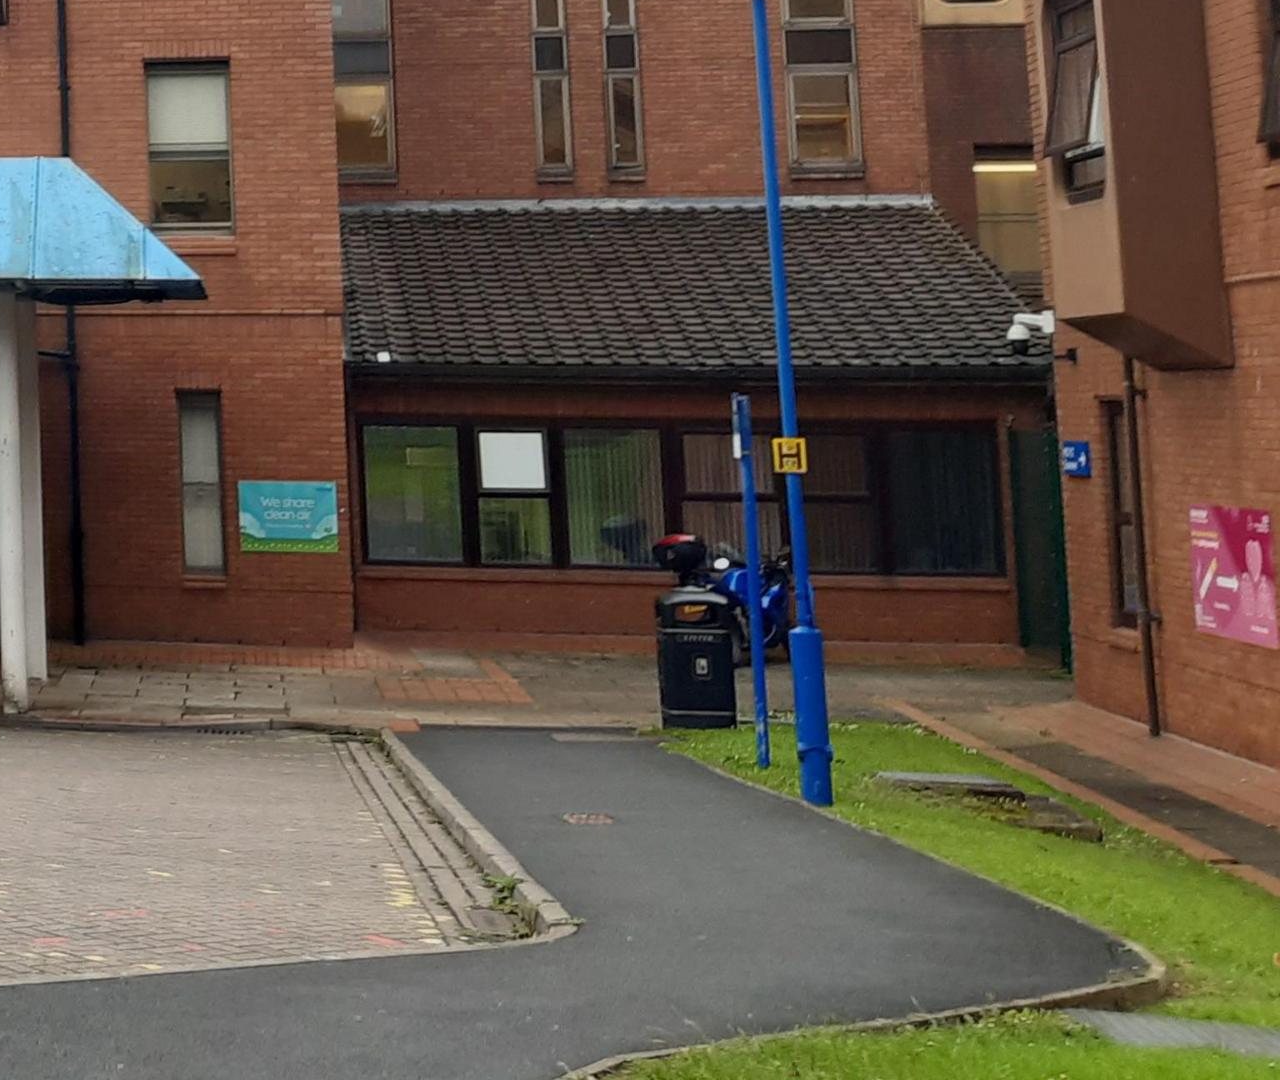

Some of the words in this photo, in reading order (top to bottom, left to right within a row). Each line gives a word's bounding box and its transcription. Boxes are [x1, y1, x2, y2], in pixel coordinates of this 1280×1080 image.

[260, 496, 280, 508] We
[282, 497, 316, 508] share
[263, 510, 295, 520] clean
